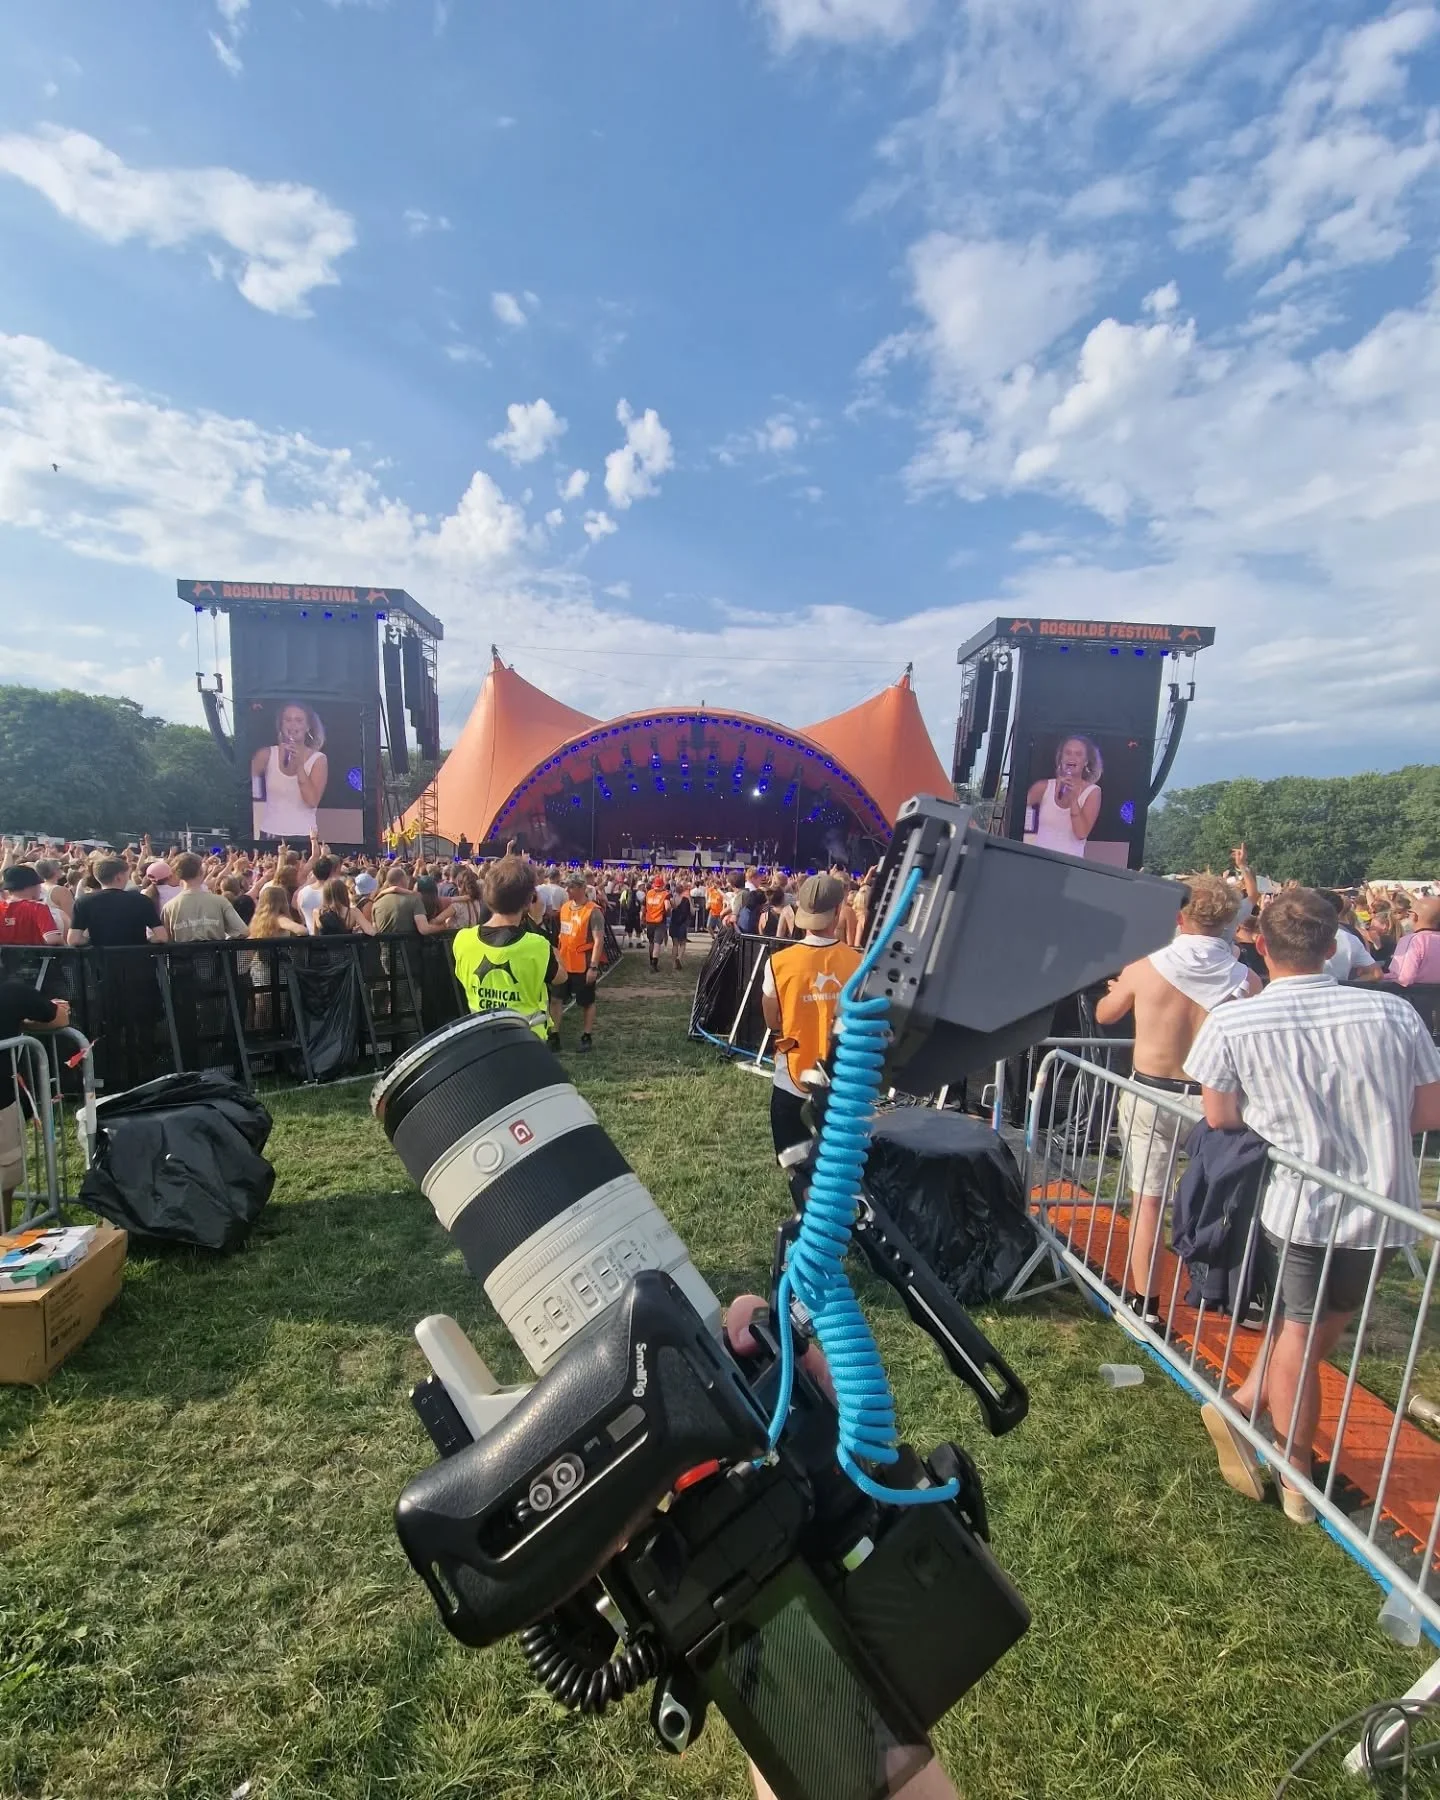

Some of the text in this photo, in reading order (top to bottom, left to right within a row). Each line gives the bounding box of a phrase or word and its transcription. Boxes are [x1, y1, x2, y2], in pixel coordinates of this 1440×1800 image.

[223, 584, 358, 602] ROSKILDE FESTIVAL
[1040, 621, 1171, 640] ROSKILDE FESTIVAL
[471, 985, 521, 1002] TCHNICAL
[478, 998, 508, 1009] CREW
[632, 1342, 648, 1398] SmallRig
